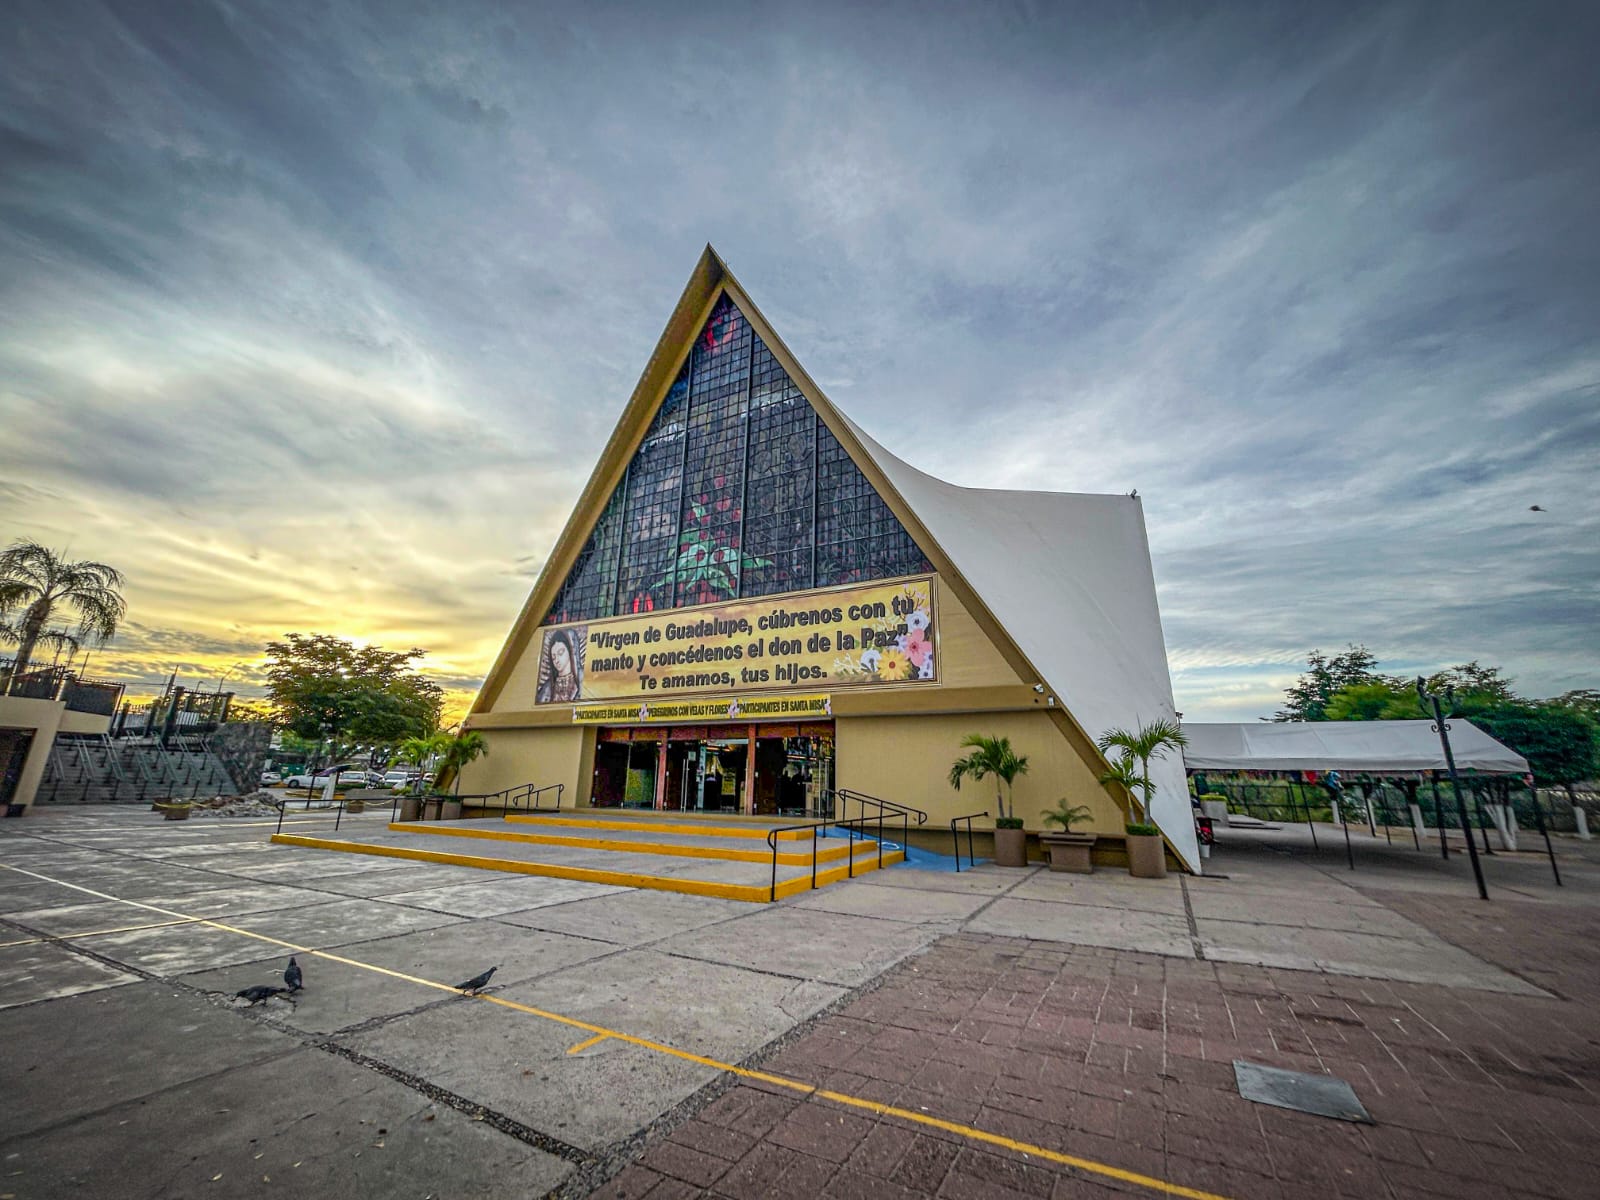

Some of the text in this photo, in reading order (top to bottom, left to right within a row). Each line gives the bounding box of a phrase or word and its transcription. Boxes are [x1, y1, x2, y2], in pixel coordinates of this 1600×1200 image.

[590, 595, 914, 651] “Virgen de Guadalupe, cúbrenos con tu
[591, 624, 909, 673] manto y concédenos el don de la Paz”
[639, 663, 828, 690] Te amamos, tus hijos.
[781, 701, 789, 712] EN
[790, 700, 808, 712] SANTA
